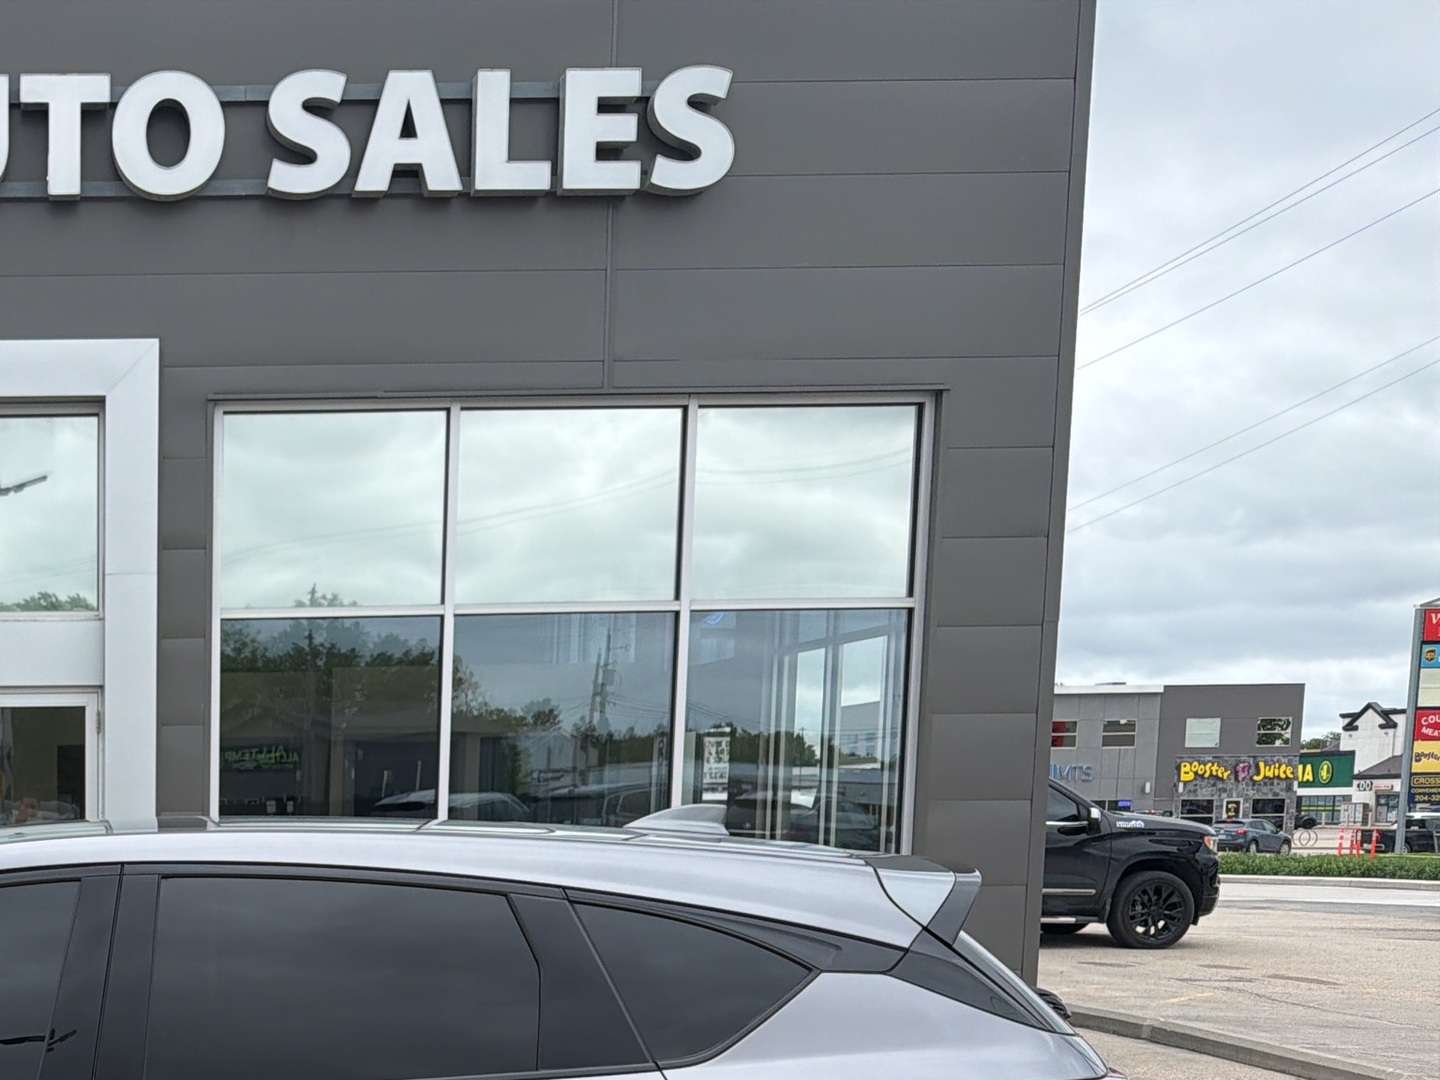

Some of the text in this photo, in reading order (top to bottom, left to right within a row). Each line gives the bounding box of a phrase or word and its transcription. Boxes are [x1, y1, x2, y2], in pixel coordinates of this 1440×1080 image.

[268, 64, 735, 197] SALES
[1179, 760, 1294, 782] Booster Juice
